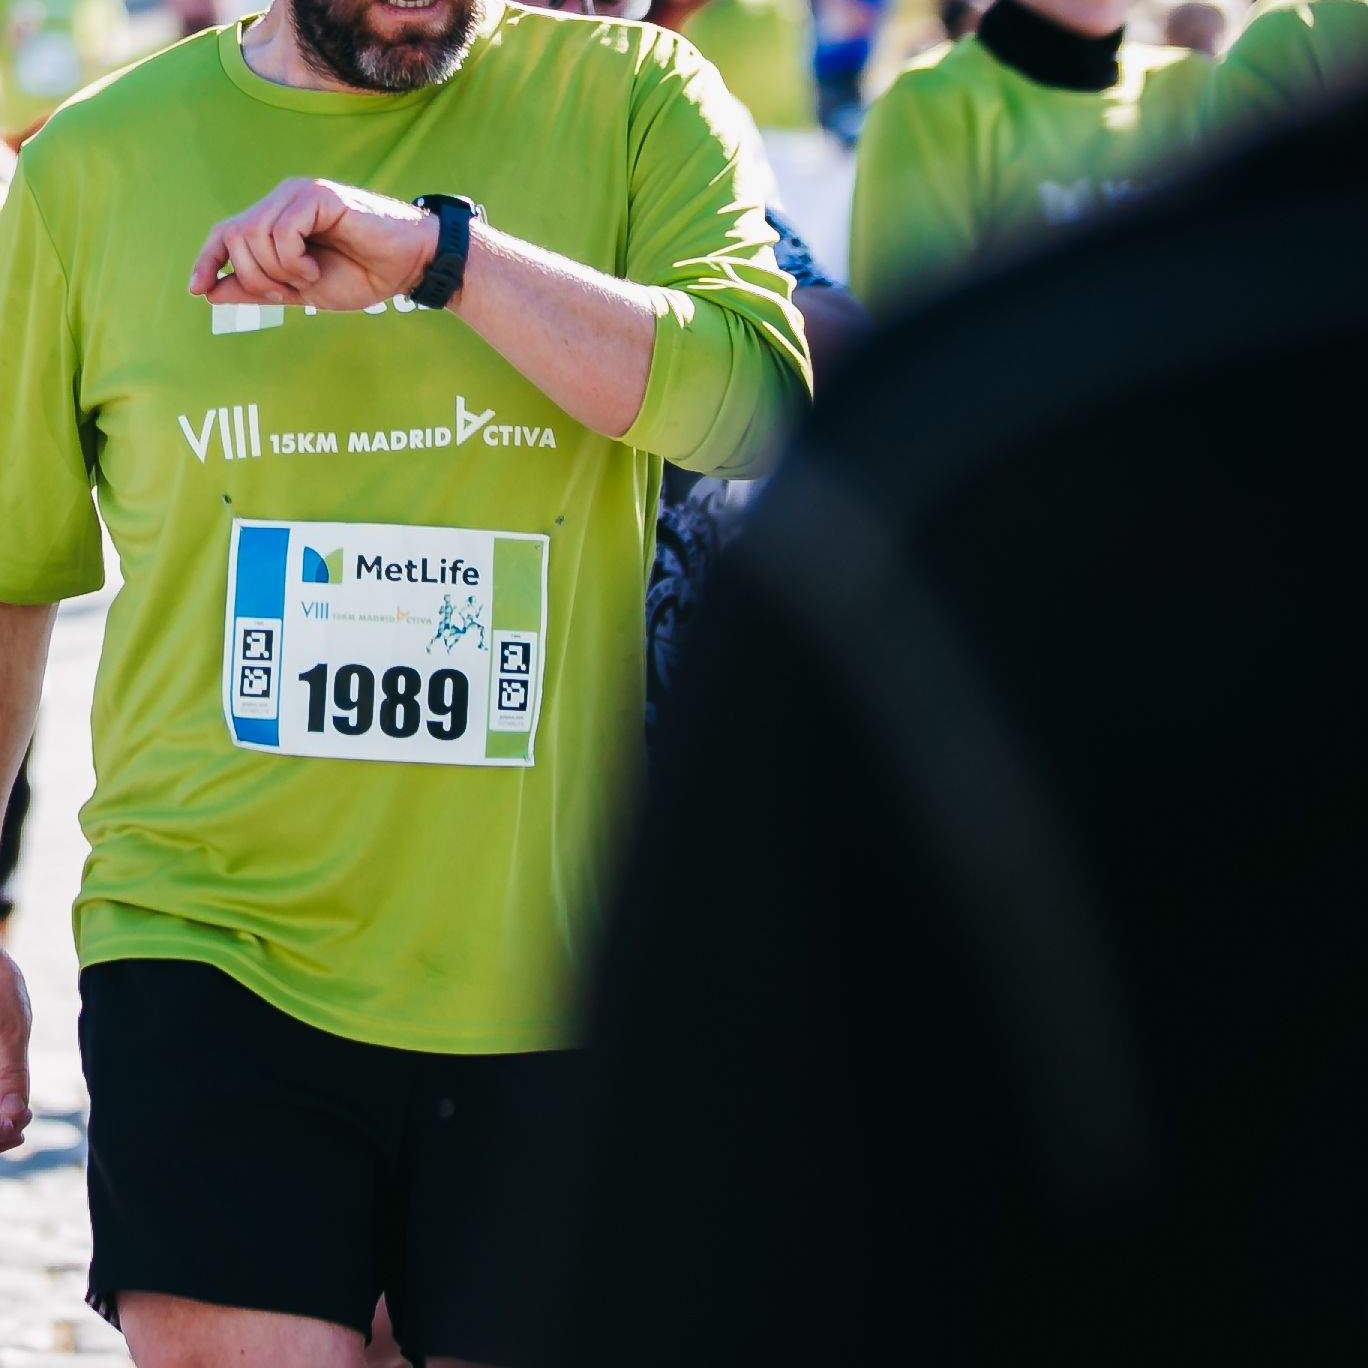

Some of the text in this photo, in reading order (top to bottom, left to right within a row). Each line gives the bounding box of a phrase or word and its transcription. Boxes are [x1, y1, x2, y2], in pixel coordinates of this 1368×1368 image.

[177, 403, 262, 463] VIII
[269, 432, 339, 454] 15KM
[355, 554, 480, 586] MetLife
[300, 601, 330, 620] VIII
[298, 663, 469, 741] 1989
